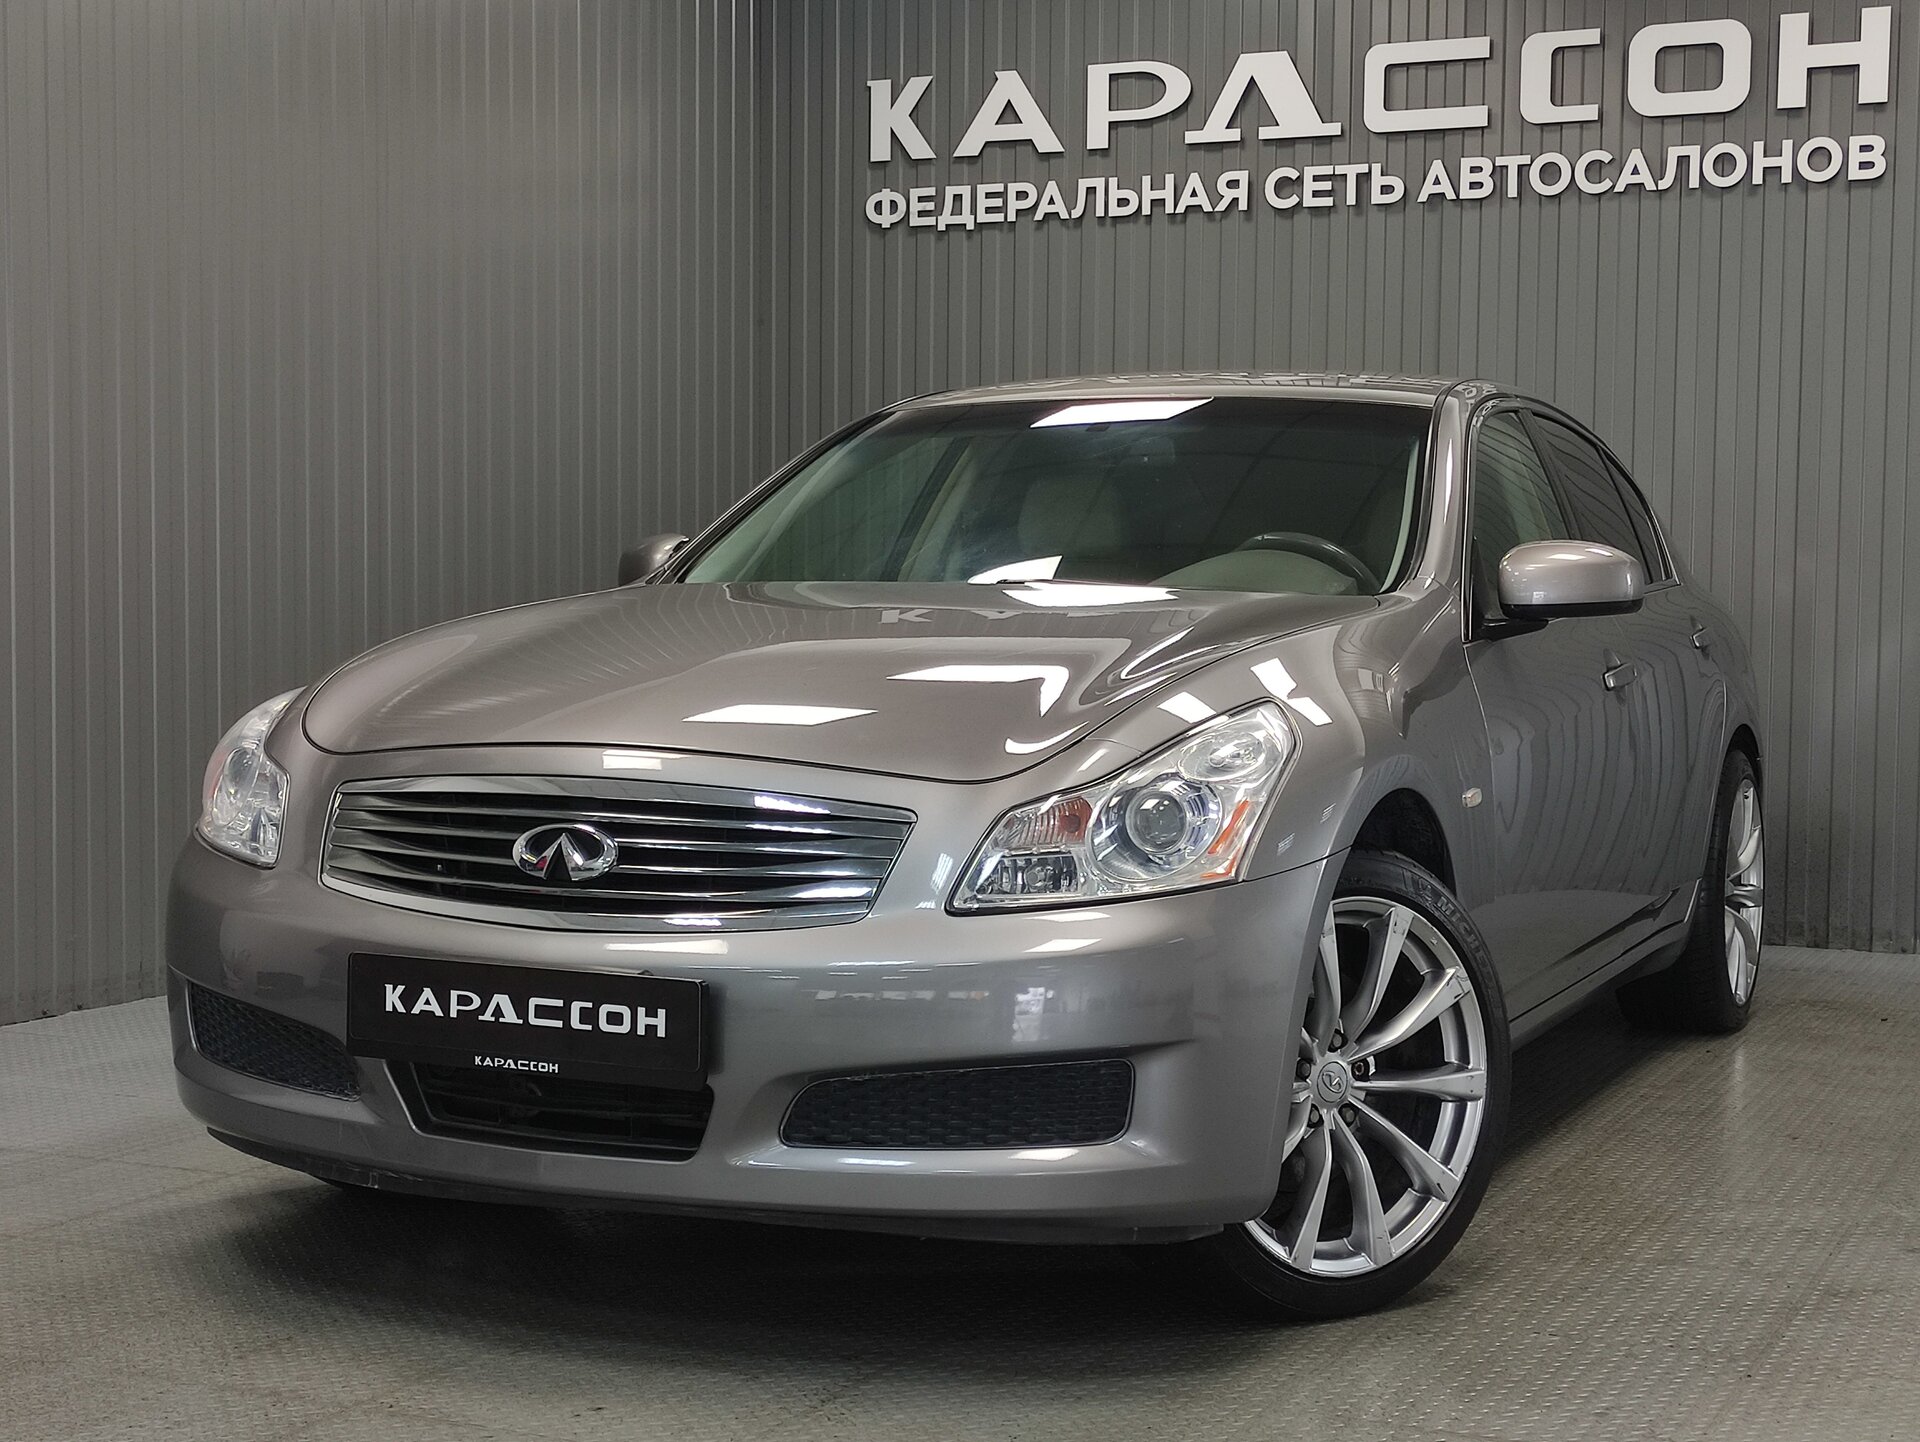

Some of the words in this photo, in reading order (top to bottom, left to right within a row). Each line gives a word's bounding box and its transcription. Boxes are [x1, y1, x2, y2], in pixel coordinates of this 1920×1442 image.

[864, 169, 1251, 232] ФЕДЕРАЛЬНАЯ
[1263, 159, 1406, 213] СЕТЬ
[1416, 133, 1889, 203] АВТОСАЛОНОВ
